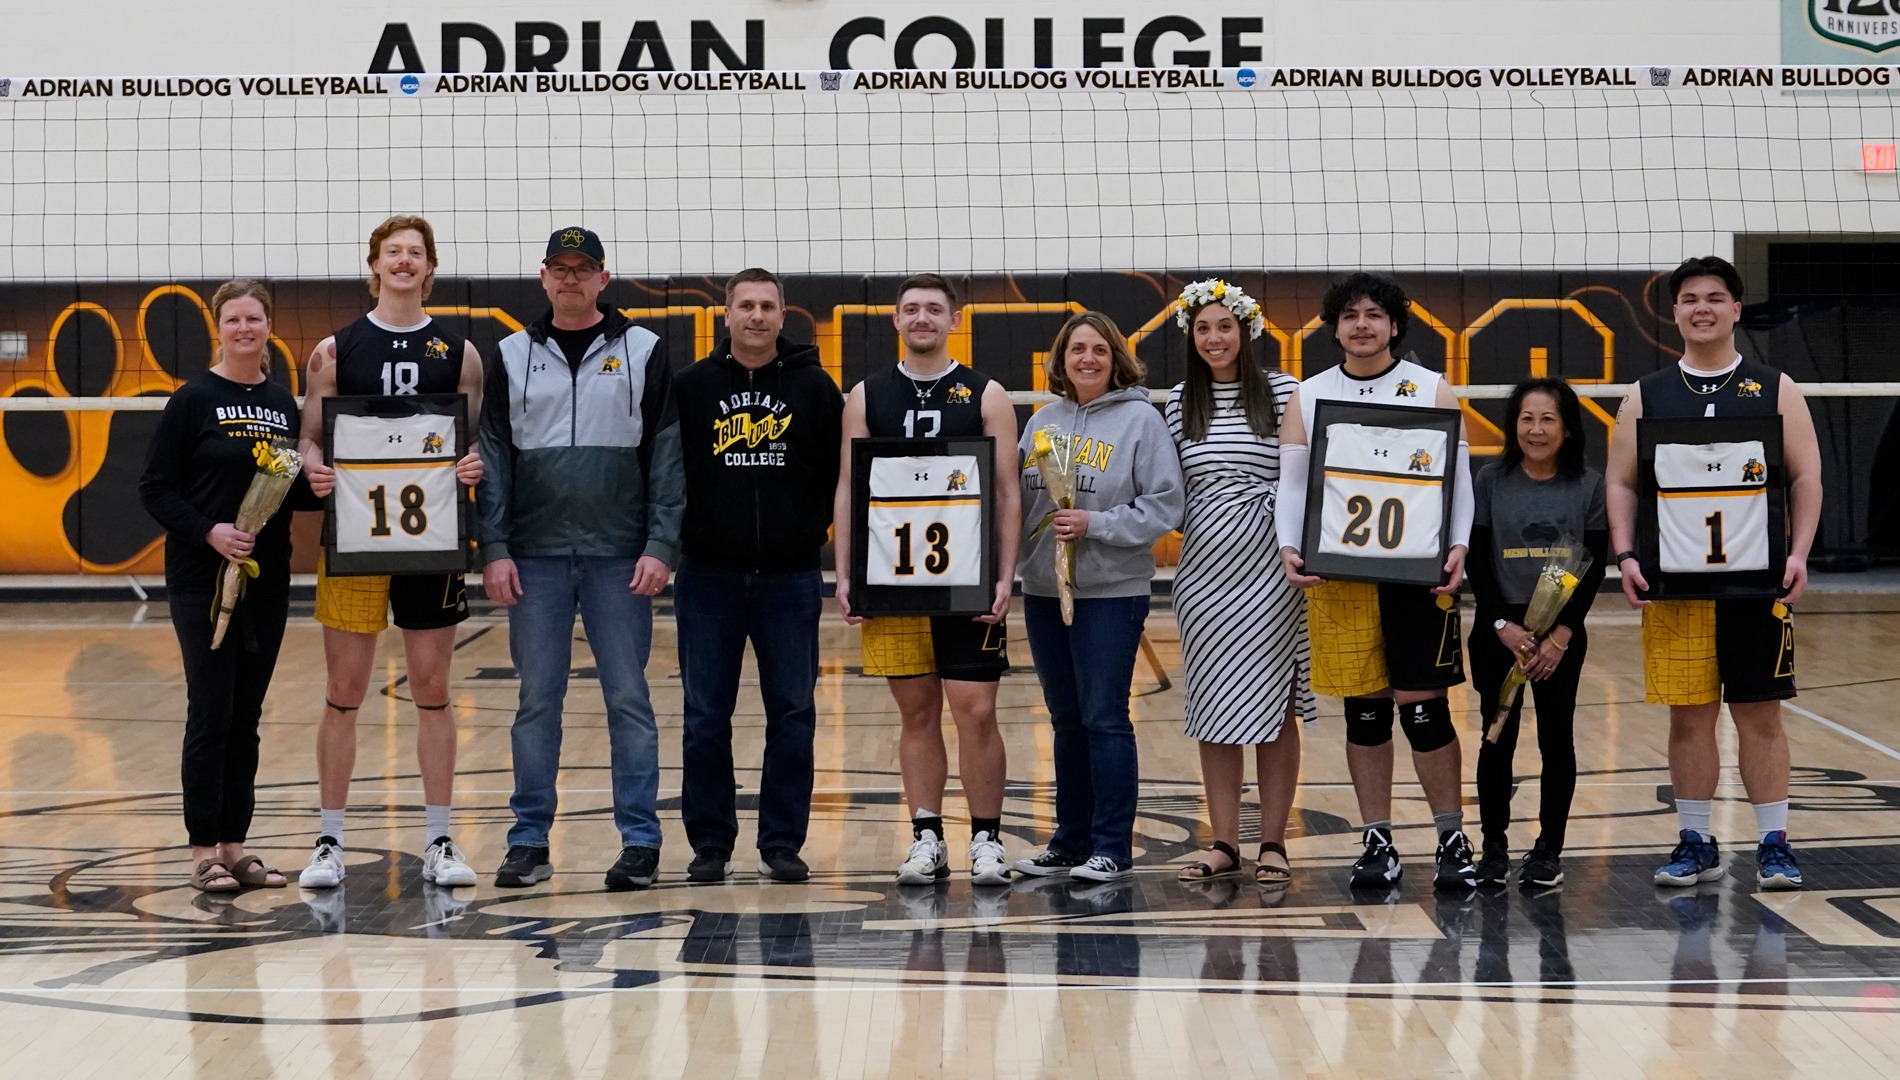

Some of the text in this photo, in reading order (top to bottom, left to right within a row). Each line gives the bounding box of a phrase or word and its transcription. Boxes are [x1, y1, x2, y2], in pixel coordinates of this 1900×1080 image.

[367, 19, 765, 74] ADRIAN
[22, 76, 388, 98] ADRIAN BULLDOG VOLLEYBALL
[434, 72, 806, 93] ADRIAN BULLDOG VOLLEYBALL
[852, 69, 1225, 90] ADRIAN BULLDOG VOLLEYBALL
[1270, 67, 1637, 88] ADRIAN BULLDOG VOLLEYBALL
[1681, 67, 1774, 87] ADRIAN
[1781, 66, 1890, 87] BULLDOG
[719, 391, 787, 415] ADRIAN
[216, 405, 288, 426] BULLDOGS
[246, 424, 271, 433] MENS
[724, 452, 786, 466] COLLEGE
[367, 483, 429, 537] 18
[1341, 495, 1406, 550] 20
[1704, 510, 1728, 565] 1
[894, 521, 951, 577] 13
